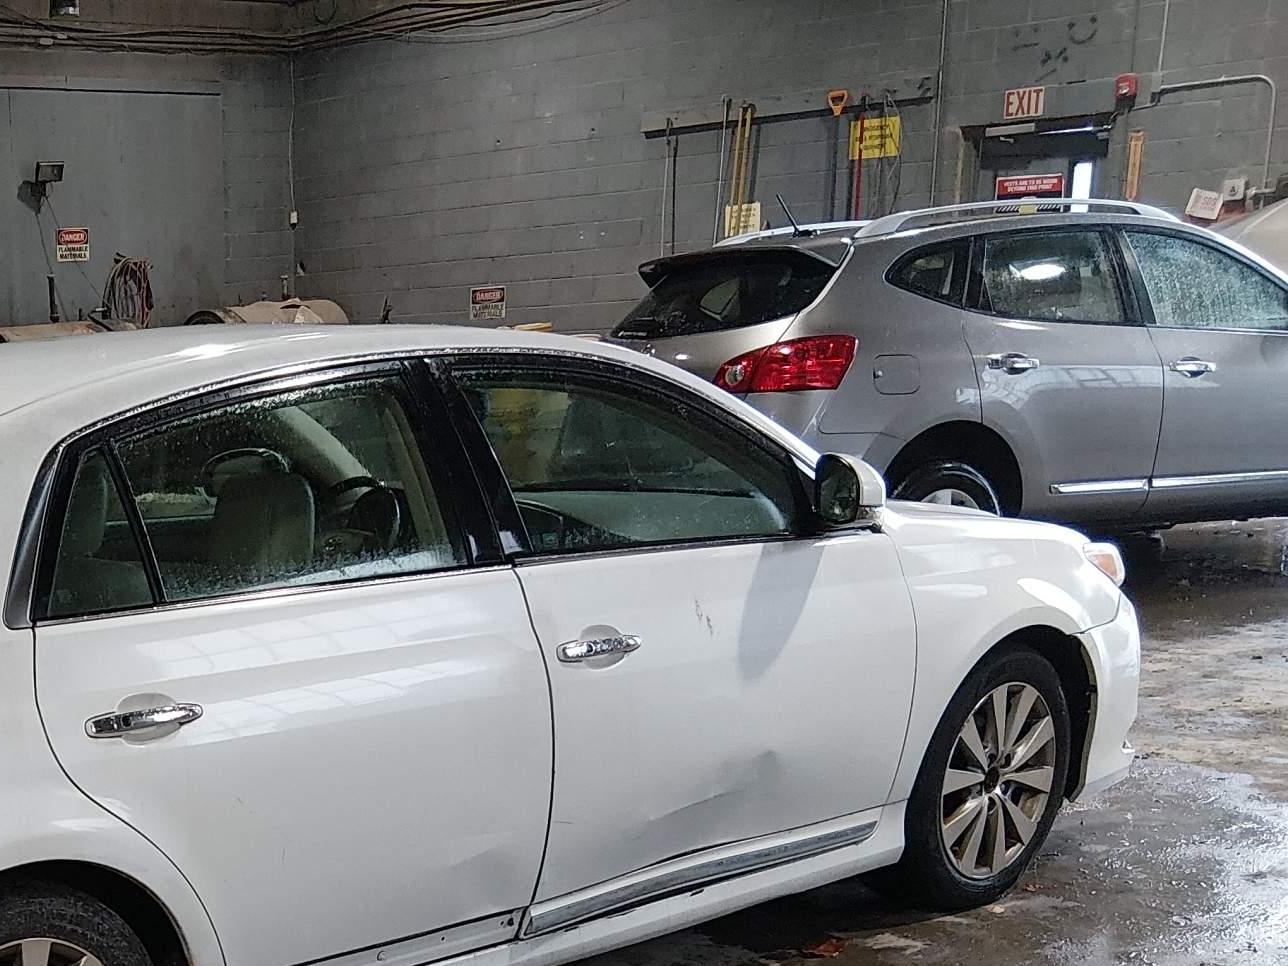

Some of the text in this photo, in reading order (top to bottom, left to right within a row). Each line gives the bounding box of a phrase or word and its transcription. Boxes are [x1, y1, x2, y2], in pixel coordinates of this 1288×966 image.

[1005, 88, 1043, 116] EXIT
[61, 232, 86, 242] DANGER
[476, 291, 501, 301] DANGER
